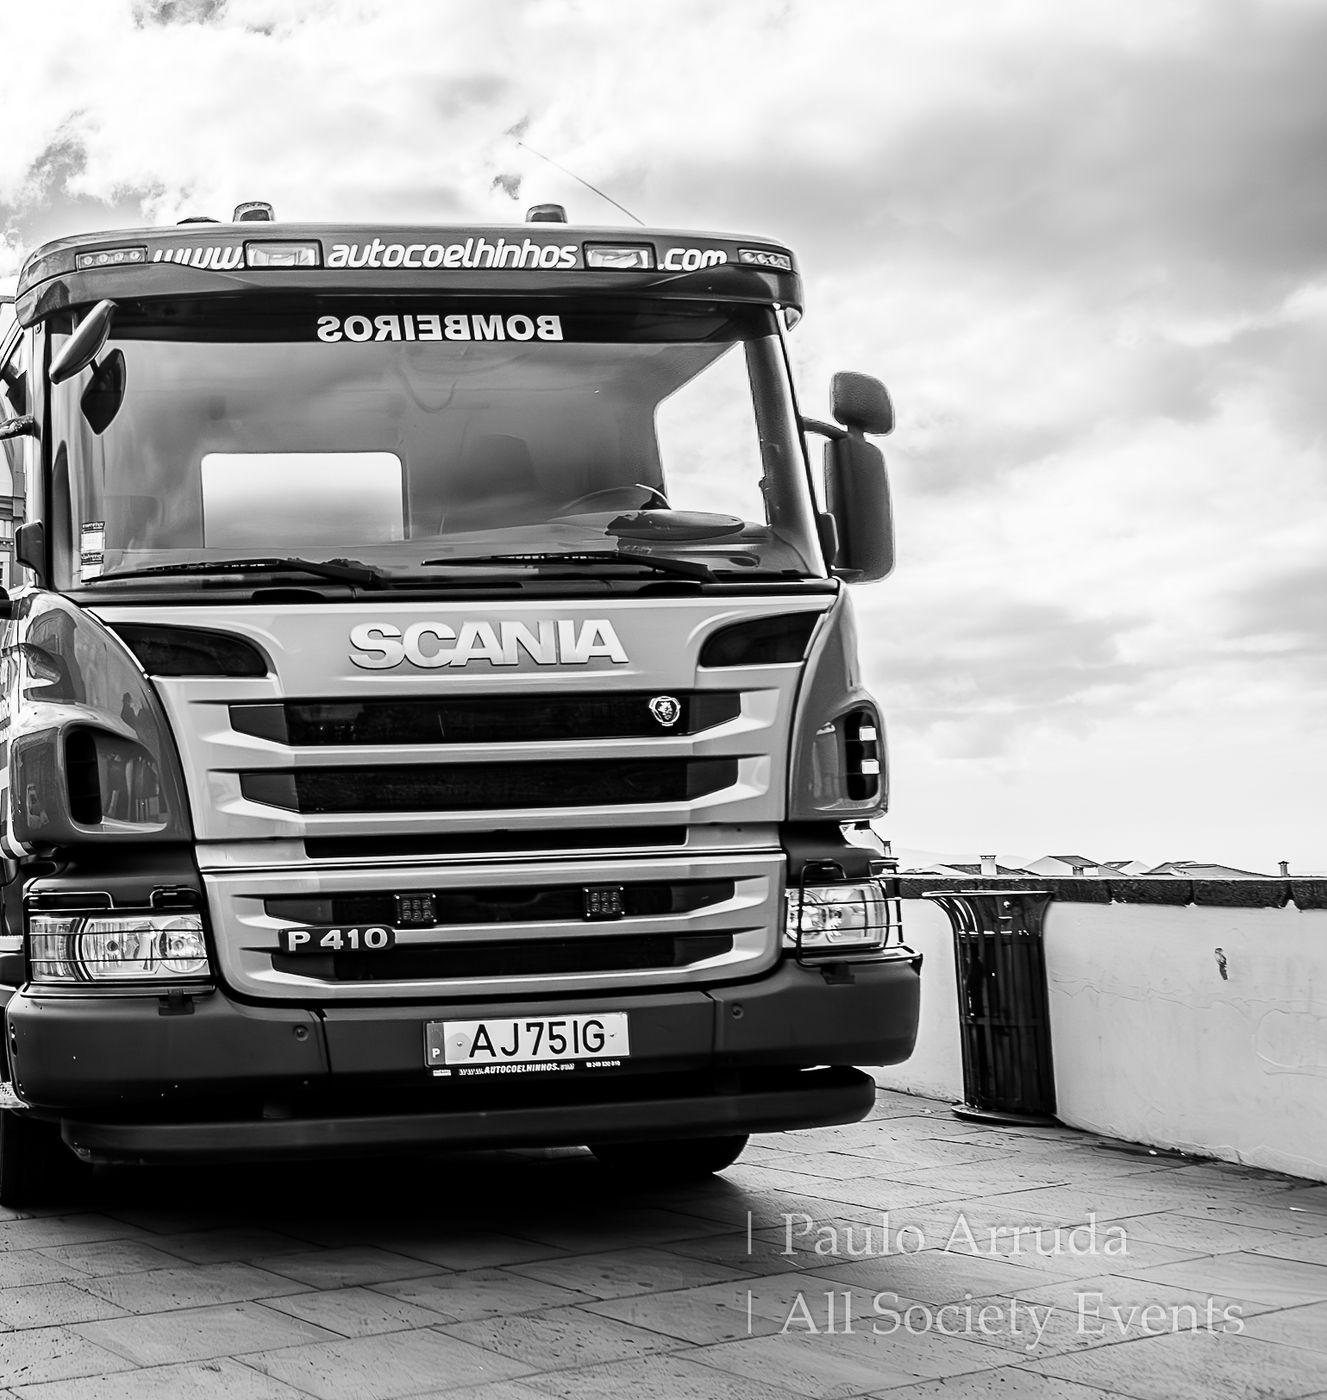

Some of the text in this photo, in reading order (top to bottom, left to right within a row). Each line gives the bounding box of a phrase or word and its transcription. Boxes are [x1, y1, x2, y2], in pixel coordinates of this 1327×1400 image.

[327, 238, 578, 269] autocoelhinhos
[657, 248, 728, 272] .com
[348, 619, 629, 669] SCANIA
[288, 928, 388, 951] P 410
[432, 1048, 440, 1058] P
